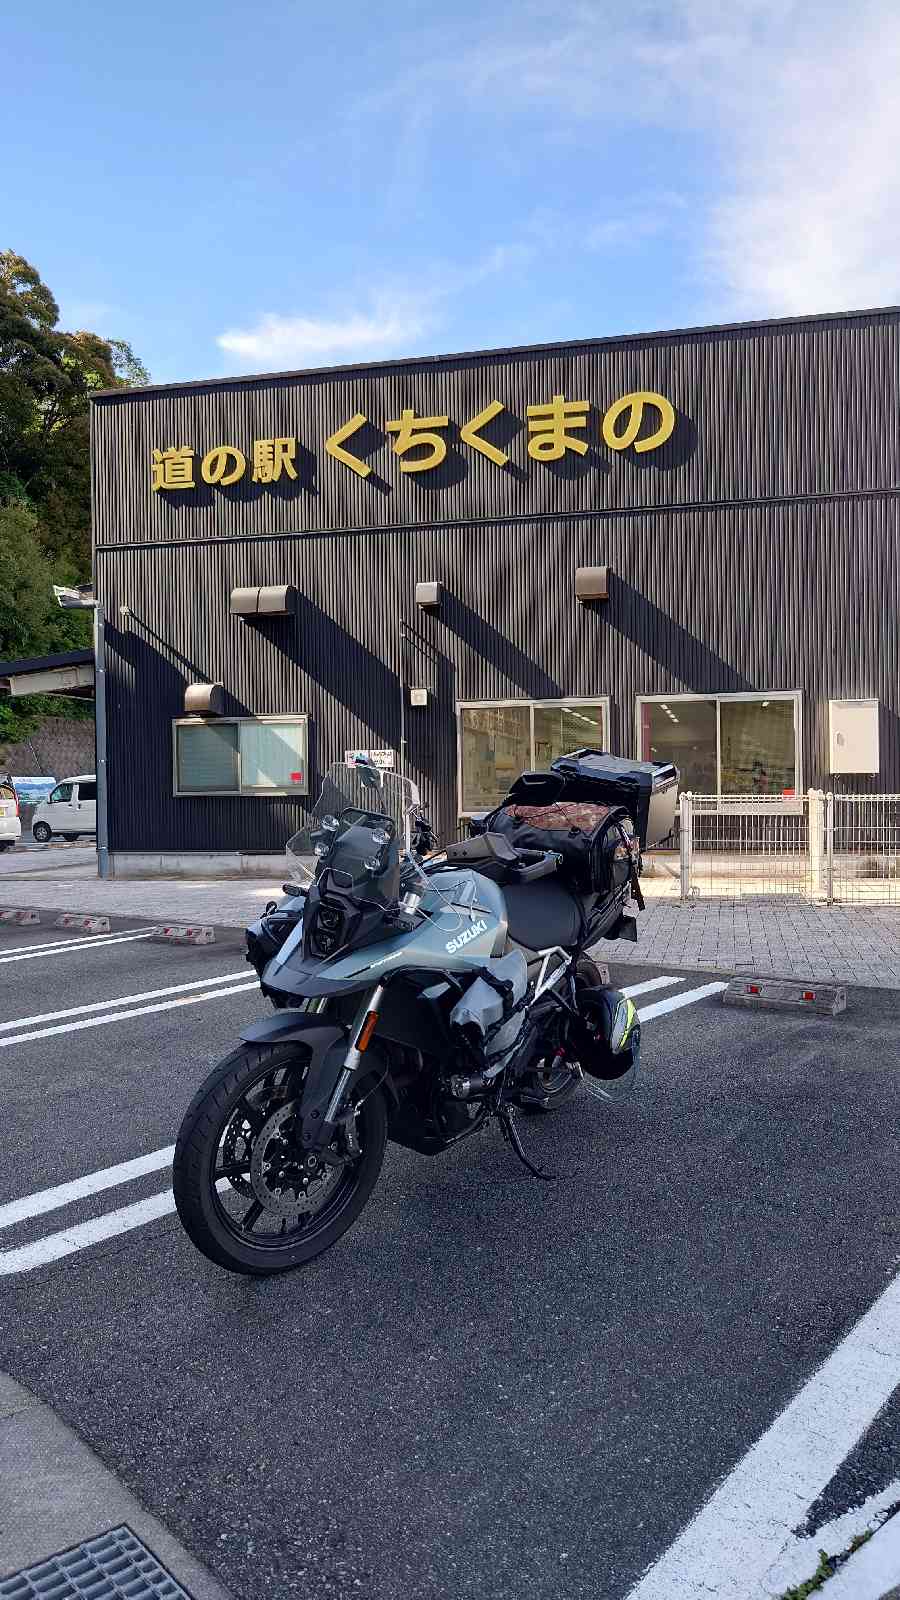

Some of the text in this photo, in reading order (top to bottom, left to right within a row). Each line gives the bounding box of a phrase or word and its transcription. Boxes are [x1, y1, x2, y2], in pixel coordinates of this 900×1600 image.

[151, 391, 676, 492] 道の駅 くちくまの
[445, 919, 488, 954] SUZUKI
